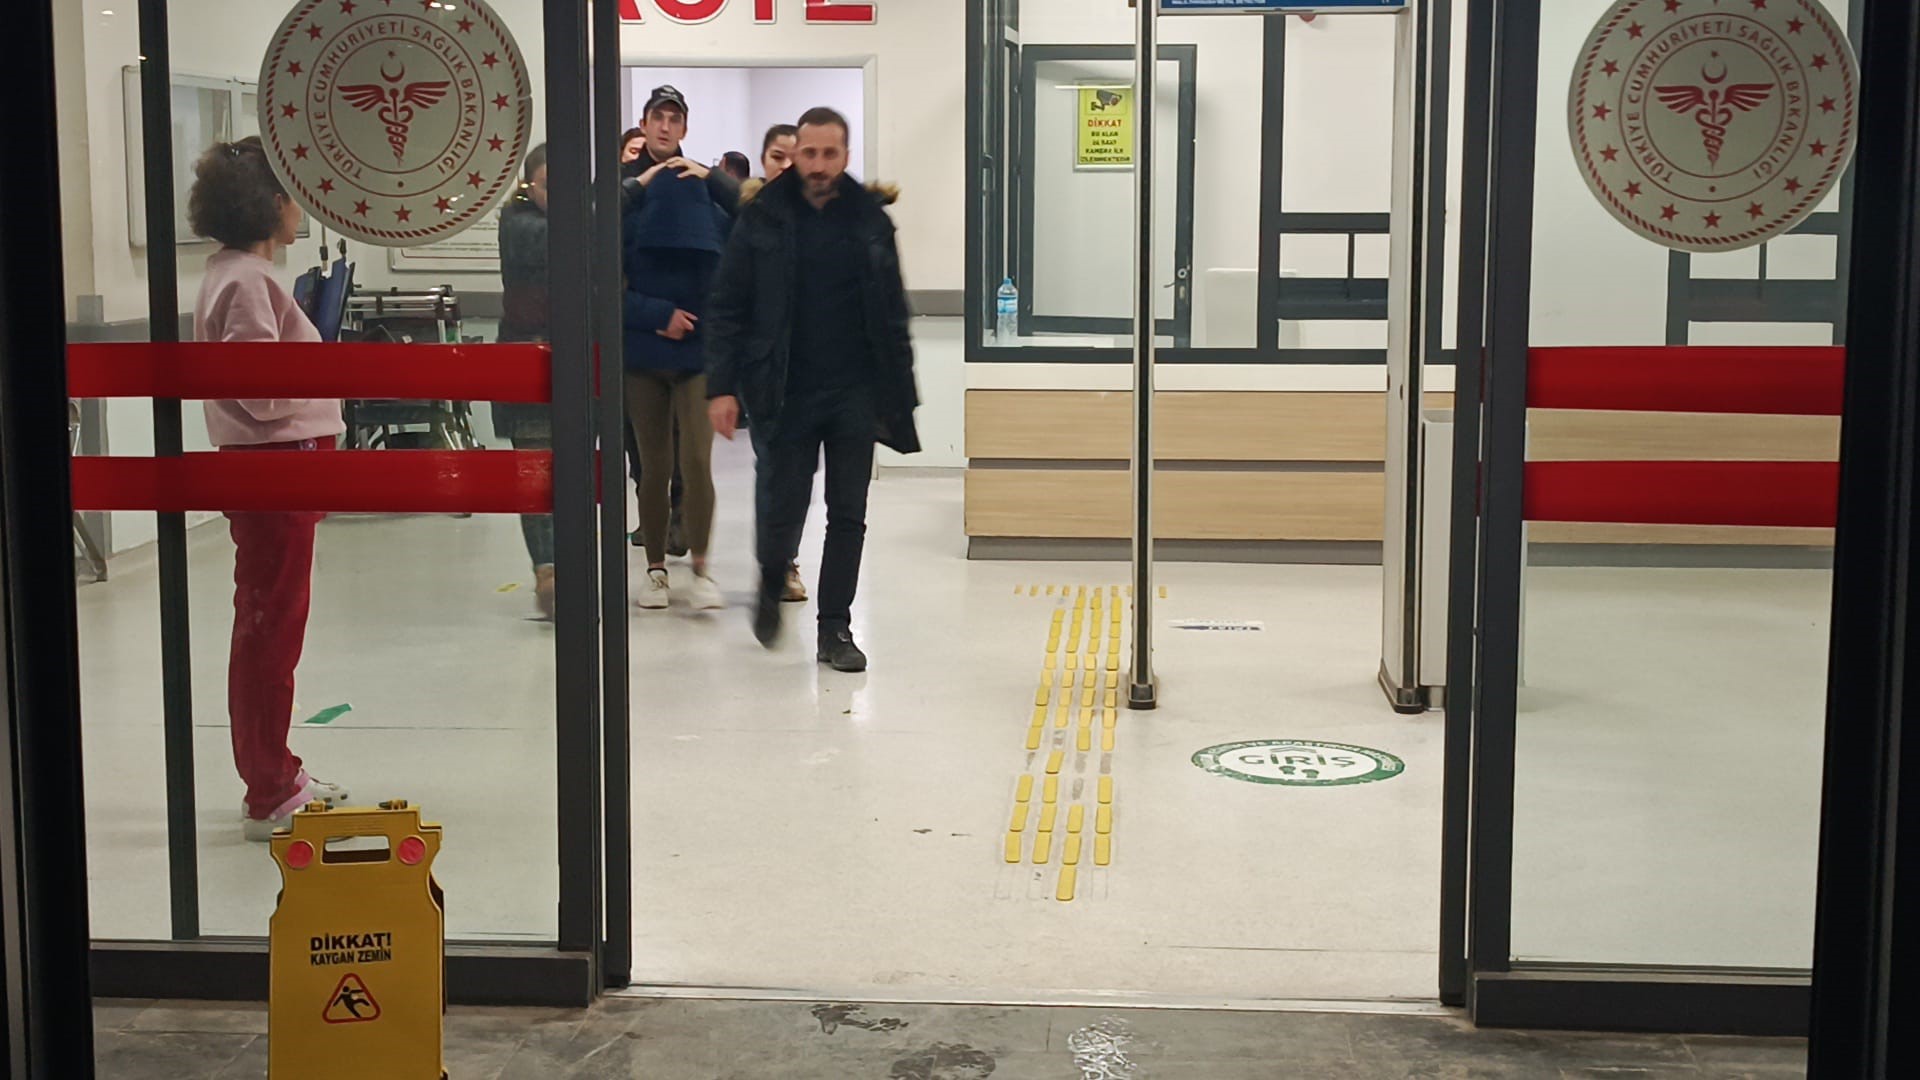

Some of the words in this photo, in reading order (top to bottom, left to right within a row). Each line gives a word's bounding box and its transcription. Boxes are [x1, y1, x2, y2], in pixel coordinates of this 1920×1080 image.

[314, 20, 404, 103] CUMHURİYETİ
[411, 25, 467, 73] SAĞLIK
[1628, 20, 1732, 104] CUMHURİYETİ
[1738, 24, 1794, 75] SAĞLIK
[313, 111, 362, 180] TÜRKİYE
[437, 78, 477, 174] BAKANLIĞI
[1087, 117, 1122, 127] DİKKAT
[1626, 112, 1674, 184] TÜRKİYE
[1753, 80, 1801, 179] BAKANLIĞI
[310, 932, 391, 951] DİKKAT!
[310, 951, 355, 966] KAYGAN
[357, 946, 391, 962] ZEMİN
